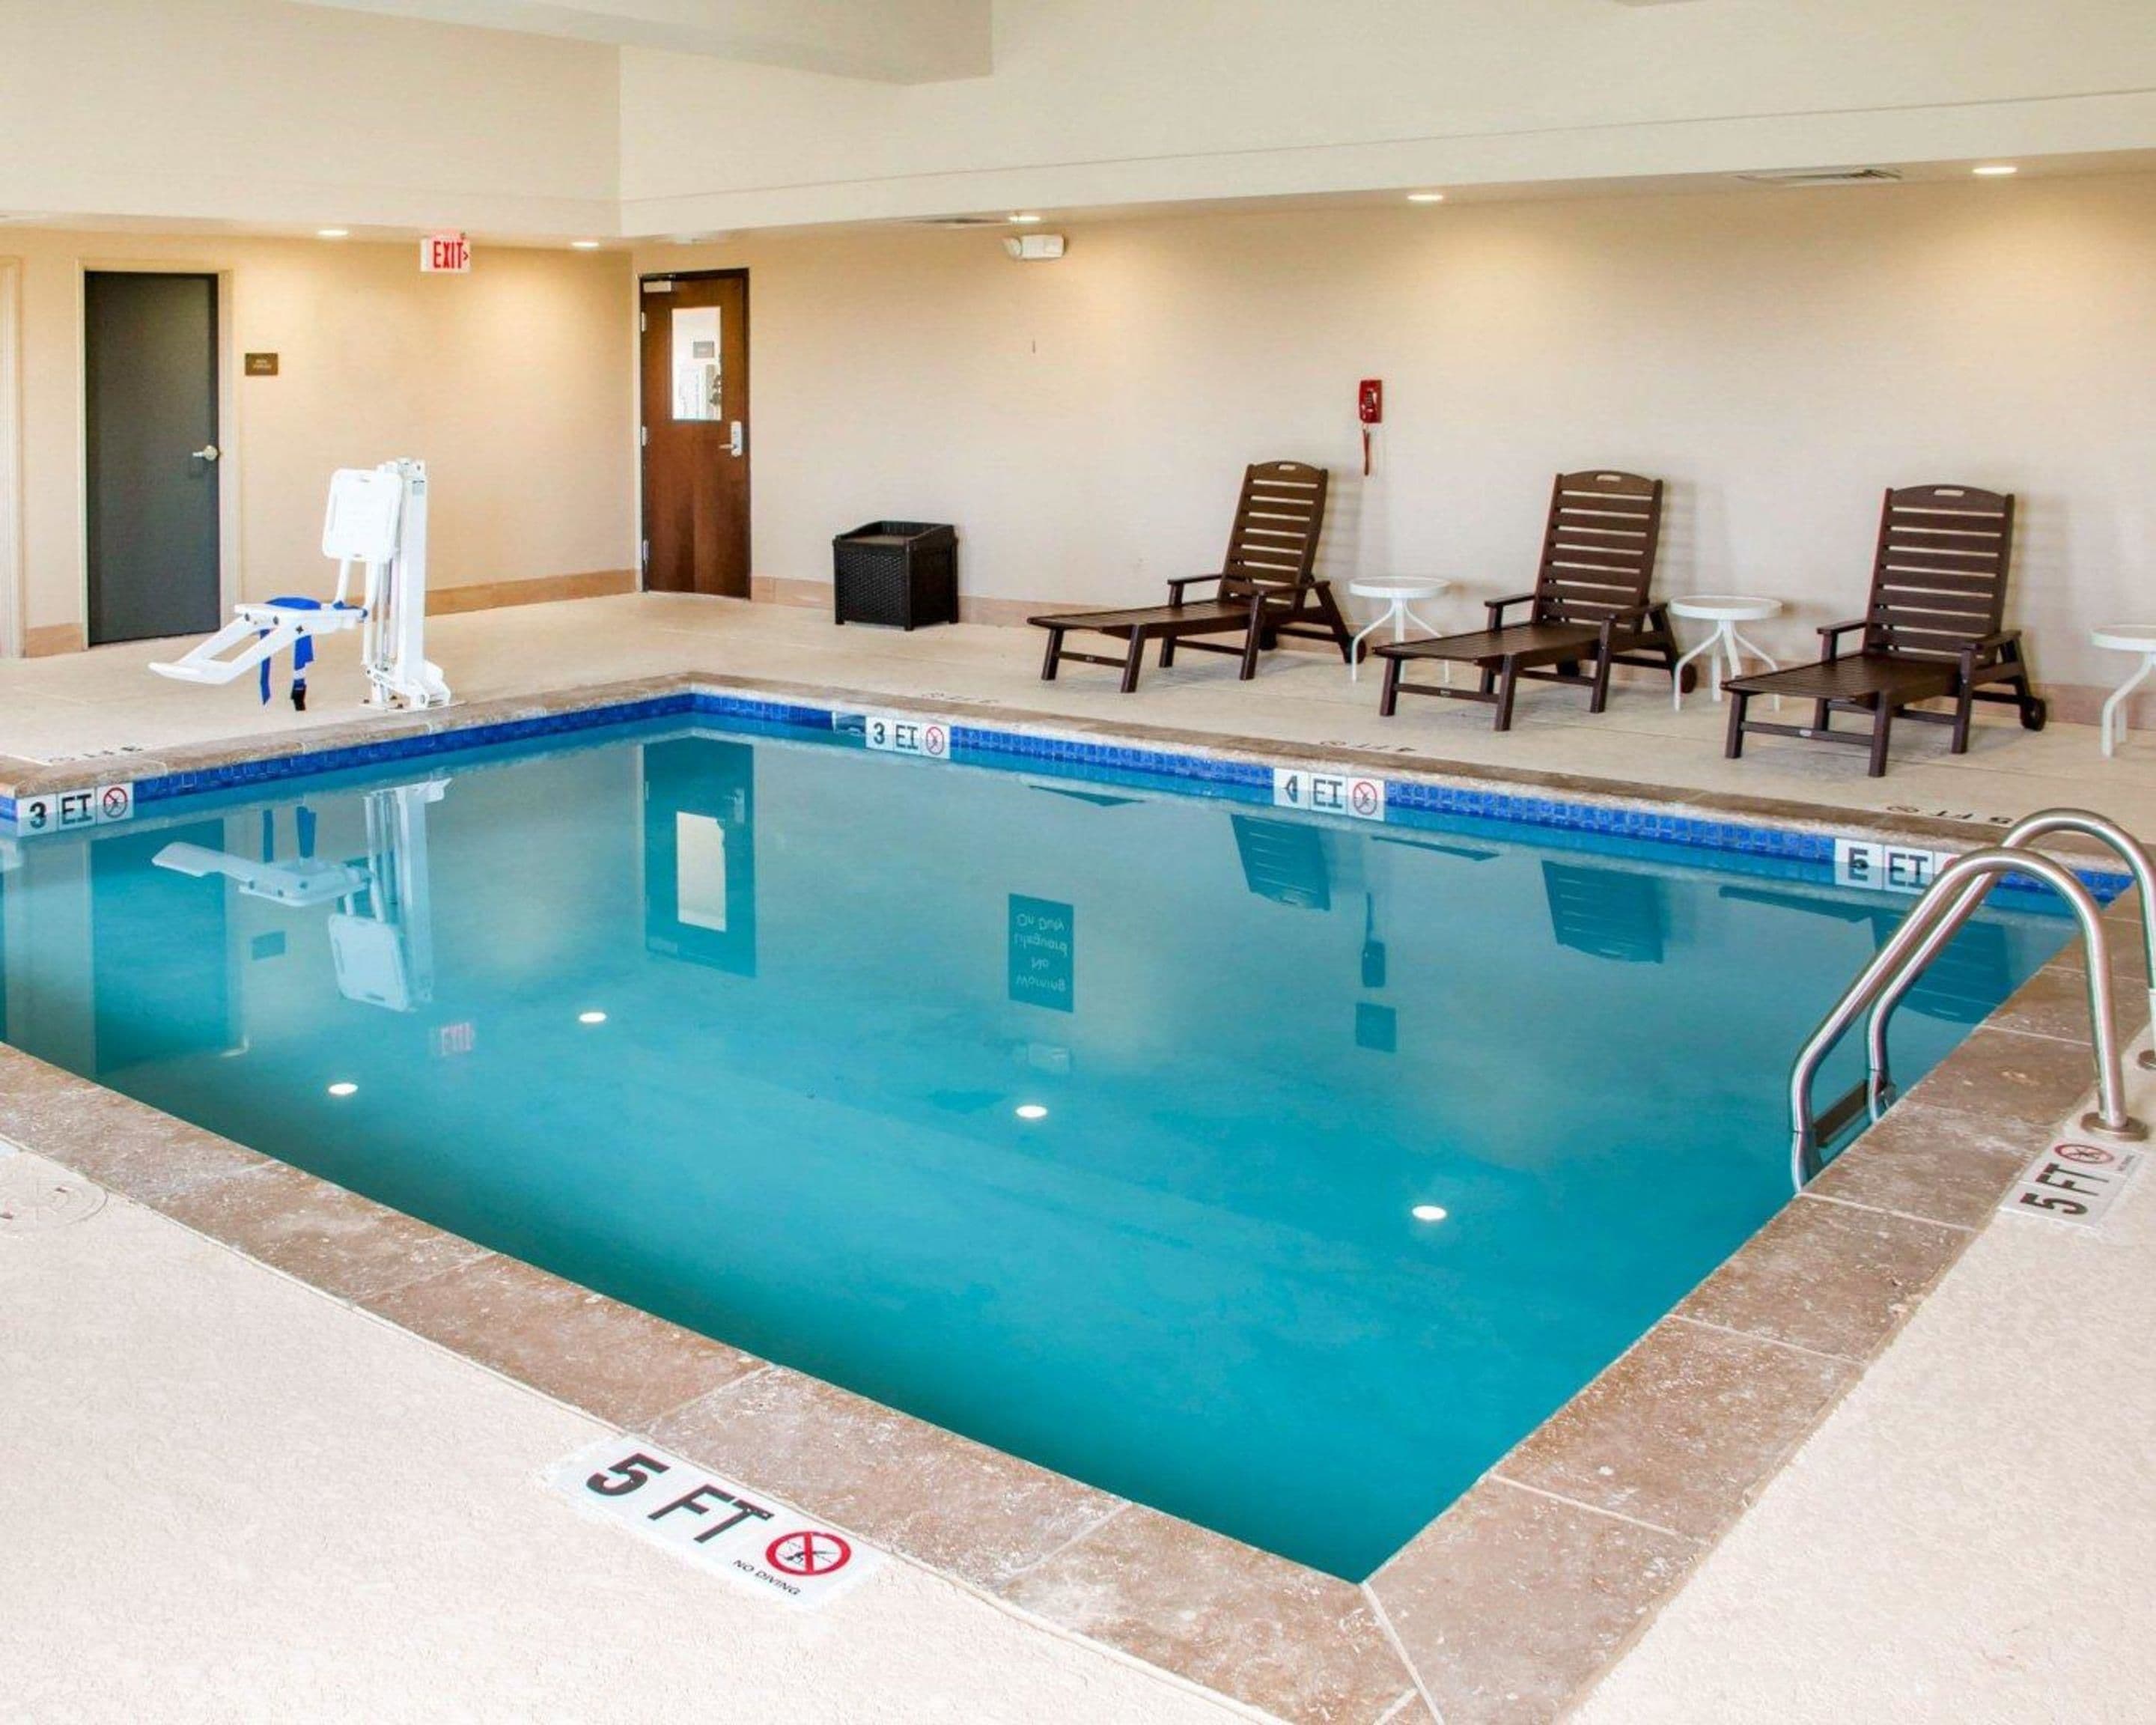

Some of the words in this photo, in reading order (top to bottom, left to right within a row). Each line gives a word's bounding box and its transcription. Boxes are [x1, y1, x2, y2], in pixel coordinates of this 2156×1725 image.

[433, 240, 463, 269] EXIT
[874, 722, 886, 744] 3
[29, 801, 46, 829] 3
[2035, 1162, 2109, 1196] FT
[2020, 1193, 2089, 1214] 5
[586, 1452, 670, 1496] 5
[648, 1484, 774, 1544] FT
[733, 1559, 755, 1572] NO
[755, 1569, 802, 1595] DIVING
